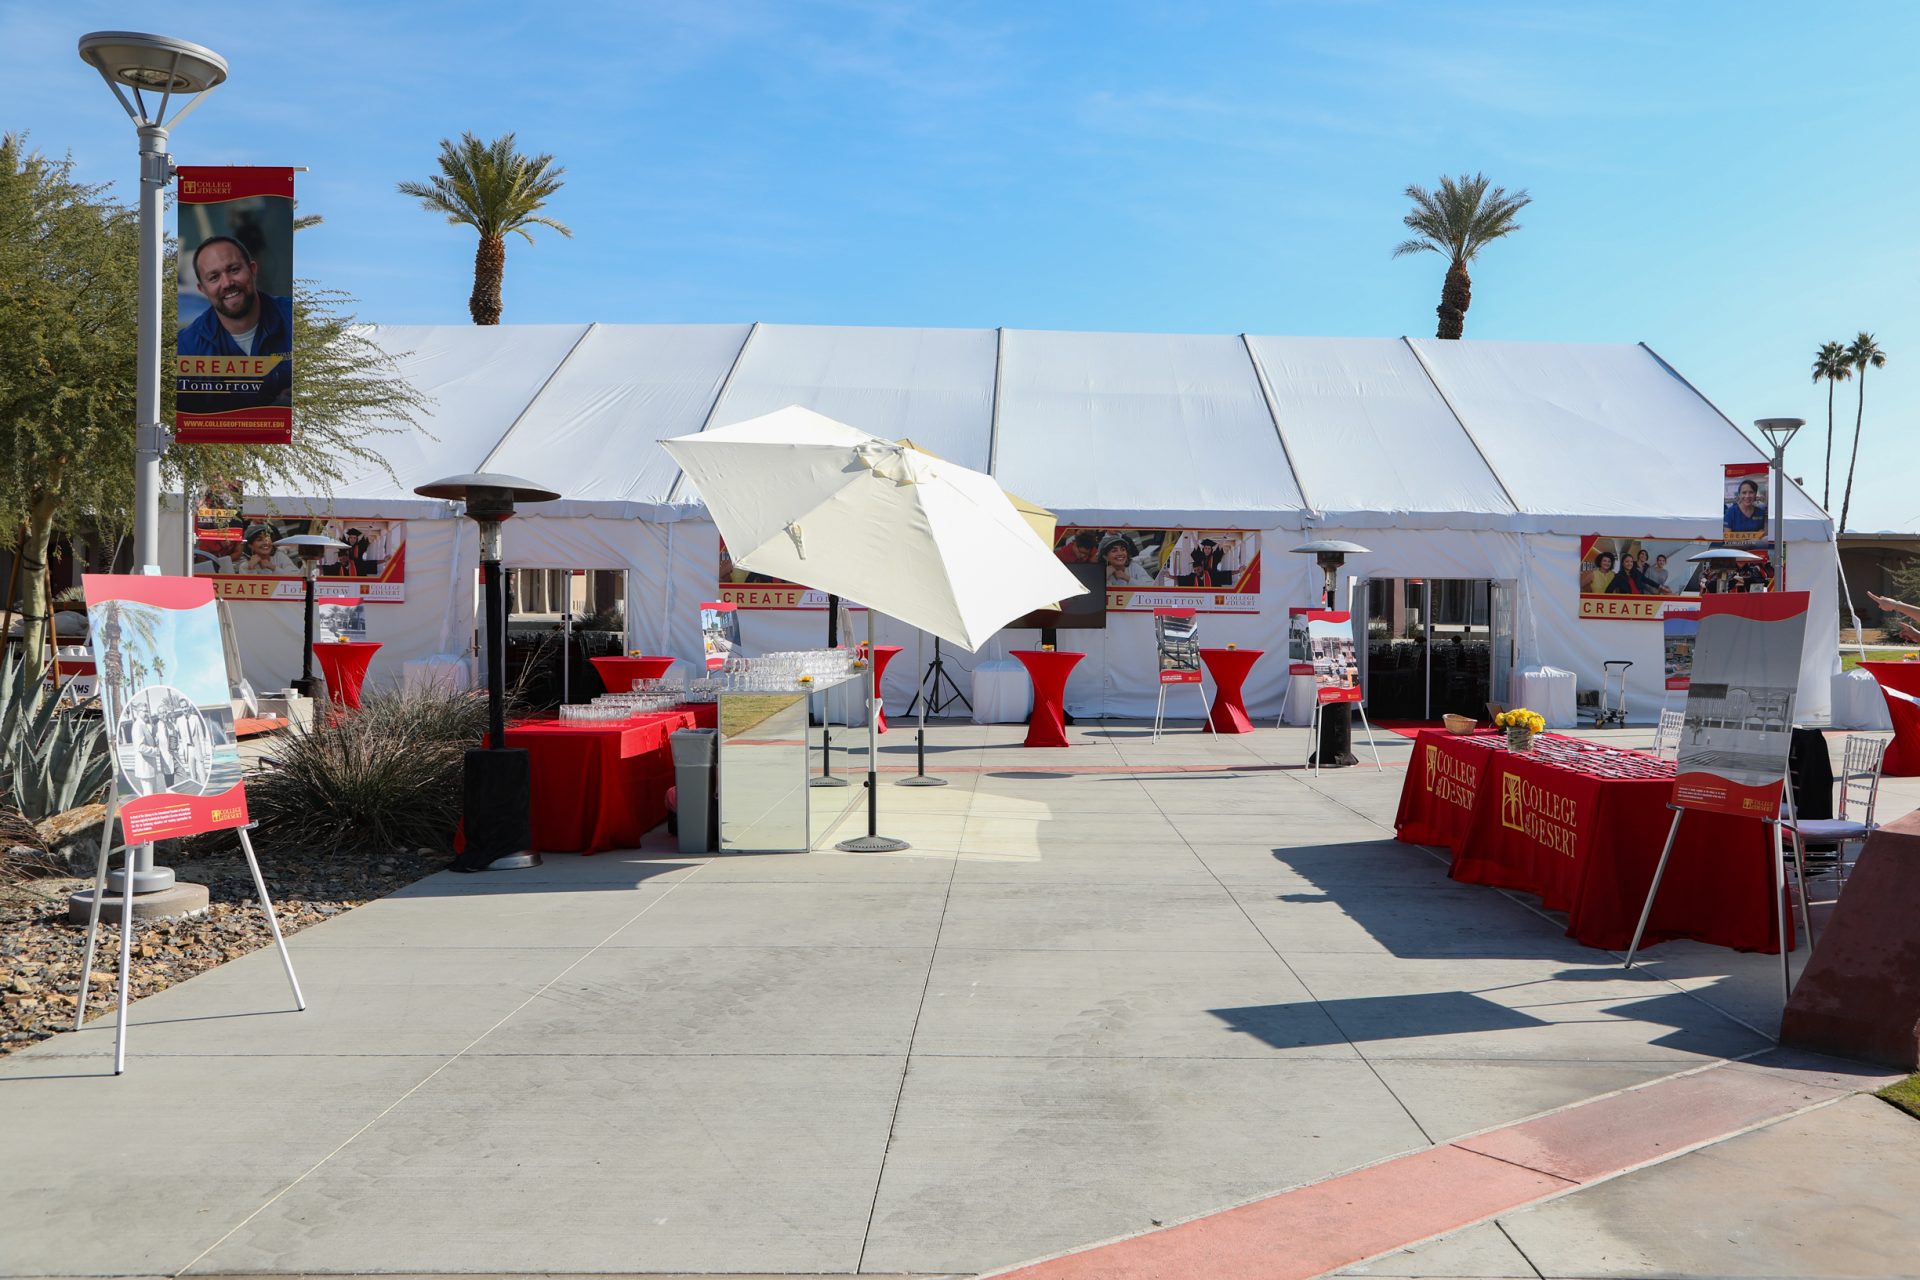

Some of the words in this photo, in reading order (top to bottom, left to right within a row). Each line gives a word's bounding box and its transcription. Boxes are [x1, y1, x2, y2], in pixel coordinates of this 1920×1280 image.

[180, 360, 264, 374] CREATE
[179, 379, 262, 391] Tomorrow
[183, 420, 285, 428] WWW.COLLEGEOFTHEDESERT.EDU
[213, 583, 270, 596] REATE
[723, 592, 796, 604] CREATE
[1135, 594, 1204, 605] Tomorrow
[1583, 602, 1653, 615] CREATE
[1436, 750, 1477, 789] COLLEGE
[1522, 780, 1577, 828] COLLEGE
[1528, 811, 1577, 859] DESERT
